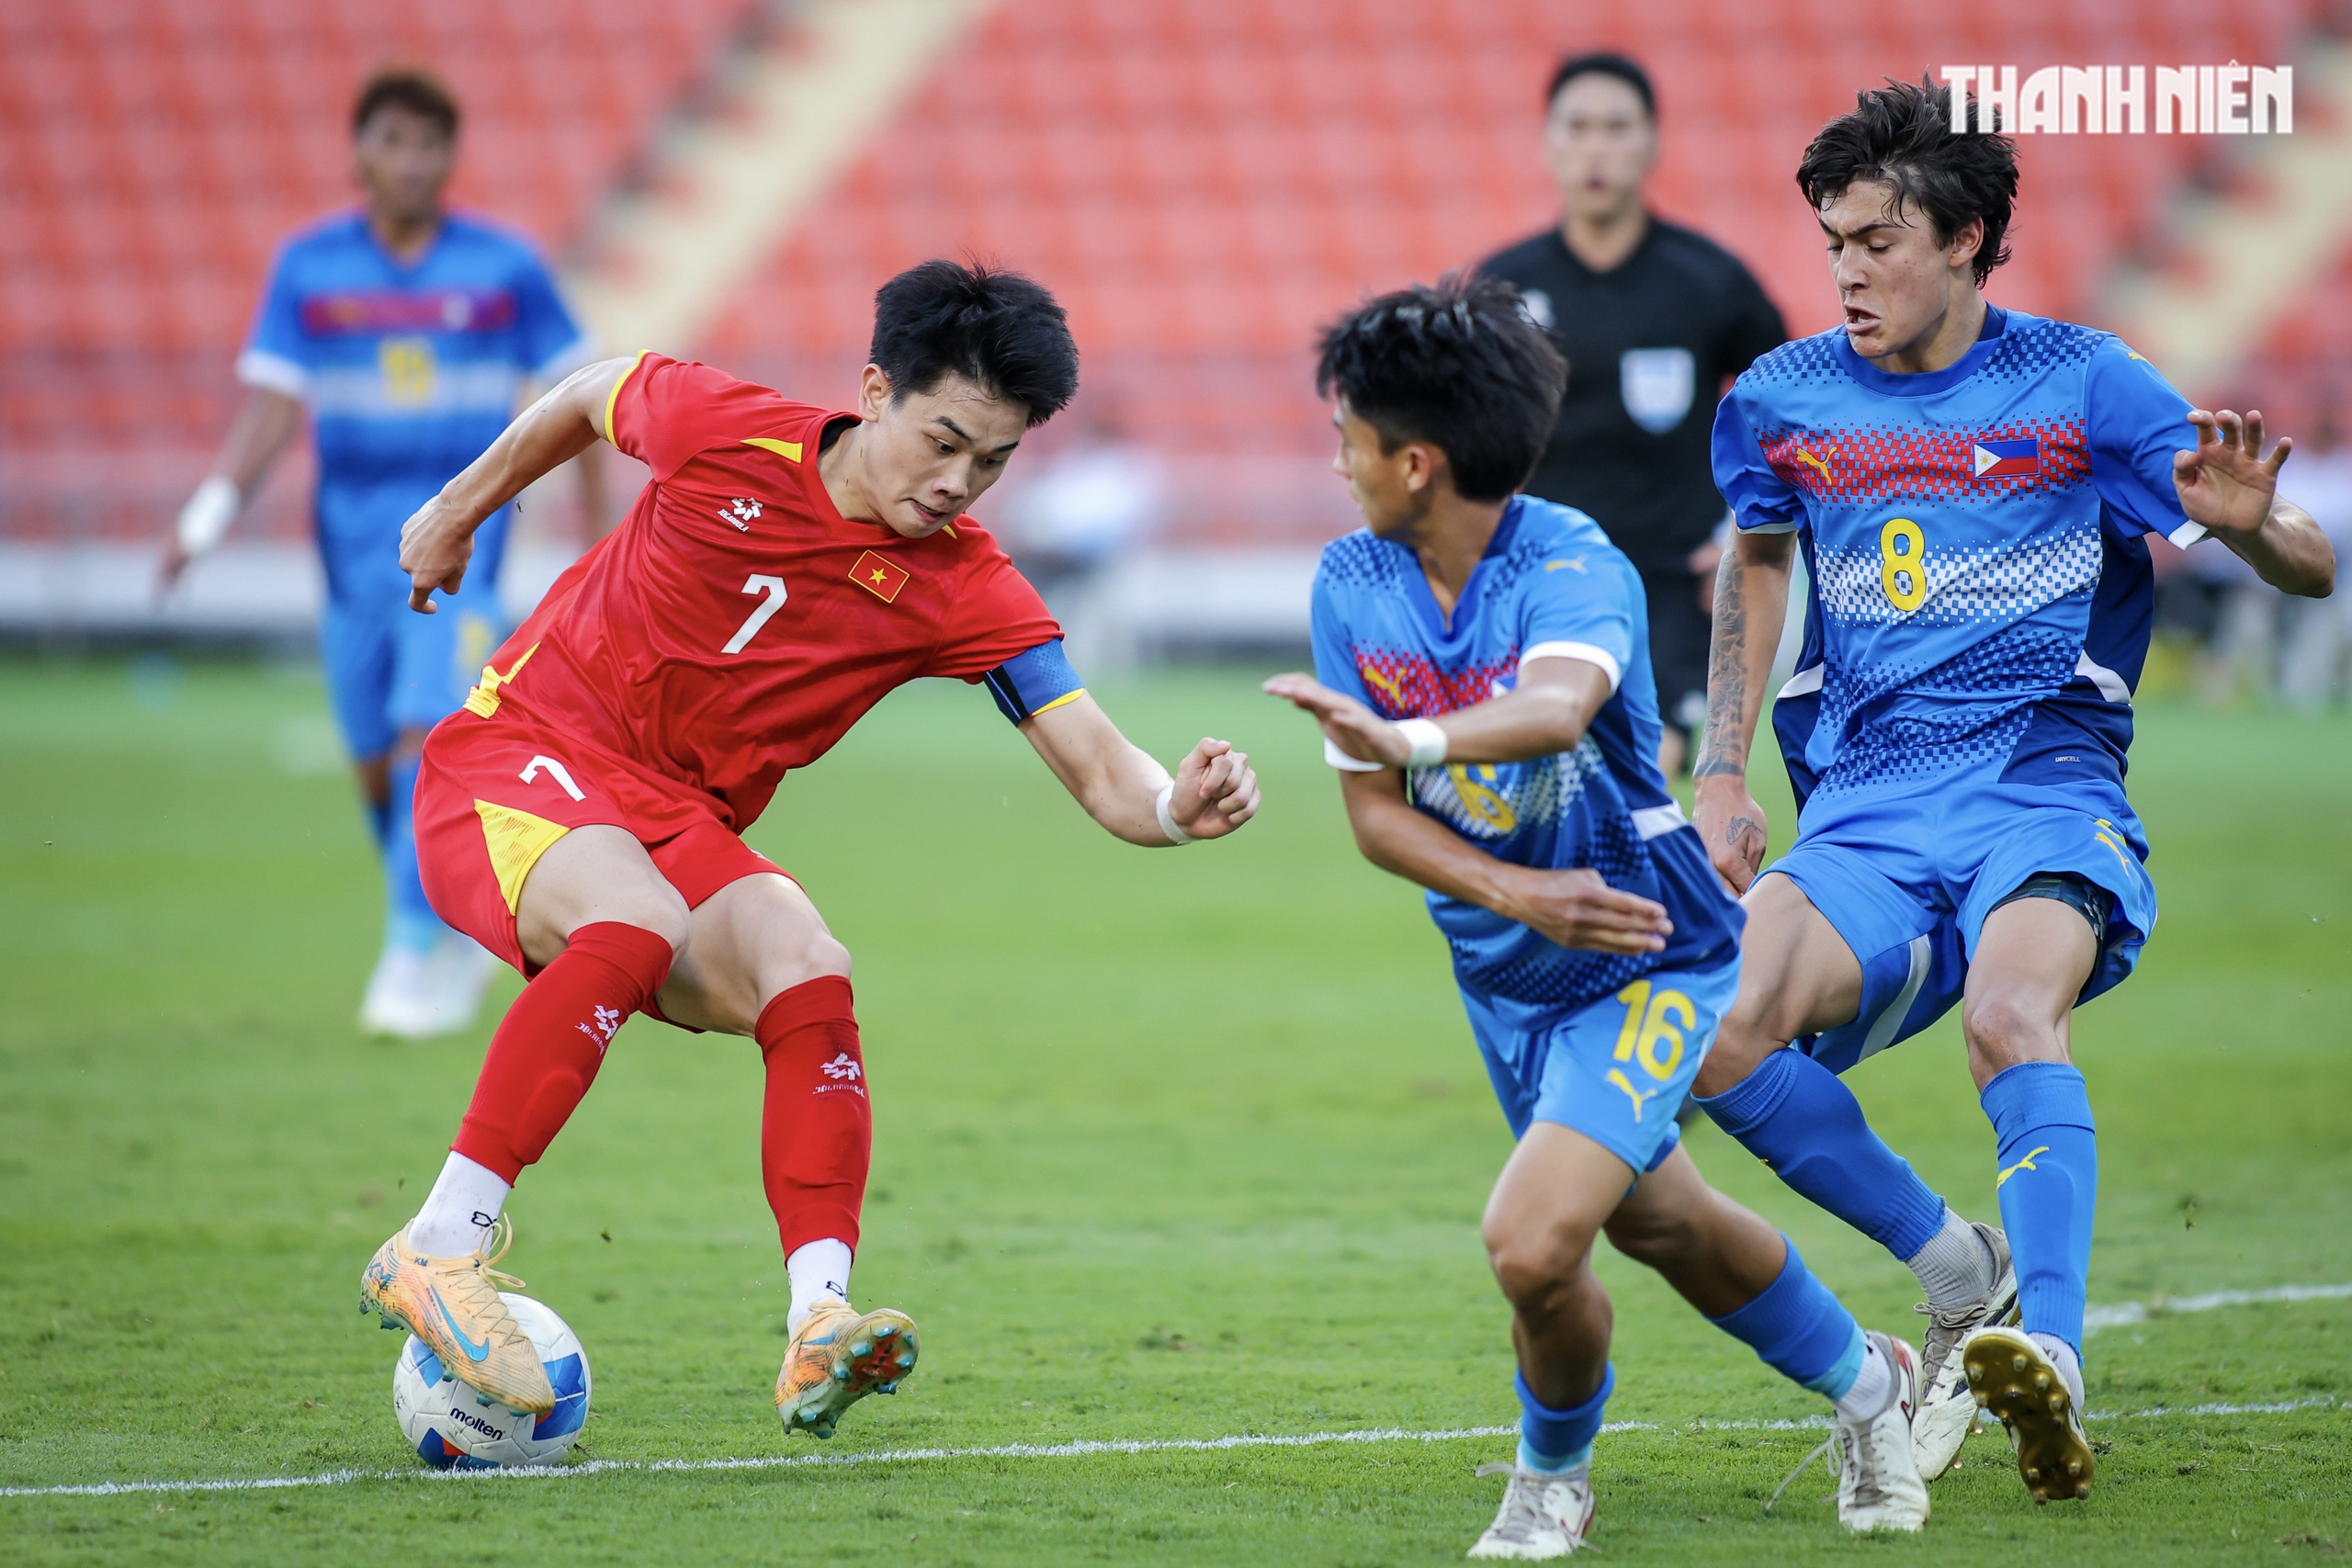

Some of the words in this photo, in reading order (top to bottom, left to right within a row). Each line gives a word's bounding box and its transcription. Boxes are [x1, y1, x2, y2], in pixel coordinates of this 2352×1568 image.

[1880, 517, 1927, 612] 8
[720, 573, 788, 654] 7
[517, 754, 587, 803] 7
[1612, 978, 1697, 1082] 16
[413, 1257, 429, 1267] KM
[449, 1407, 503, 1440] molten
